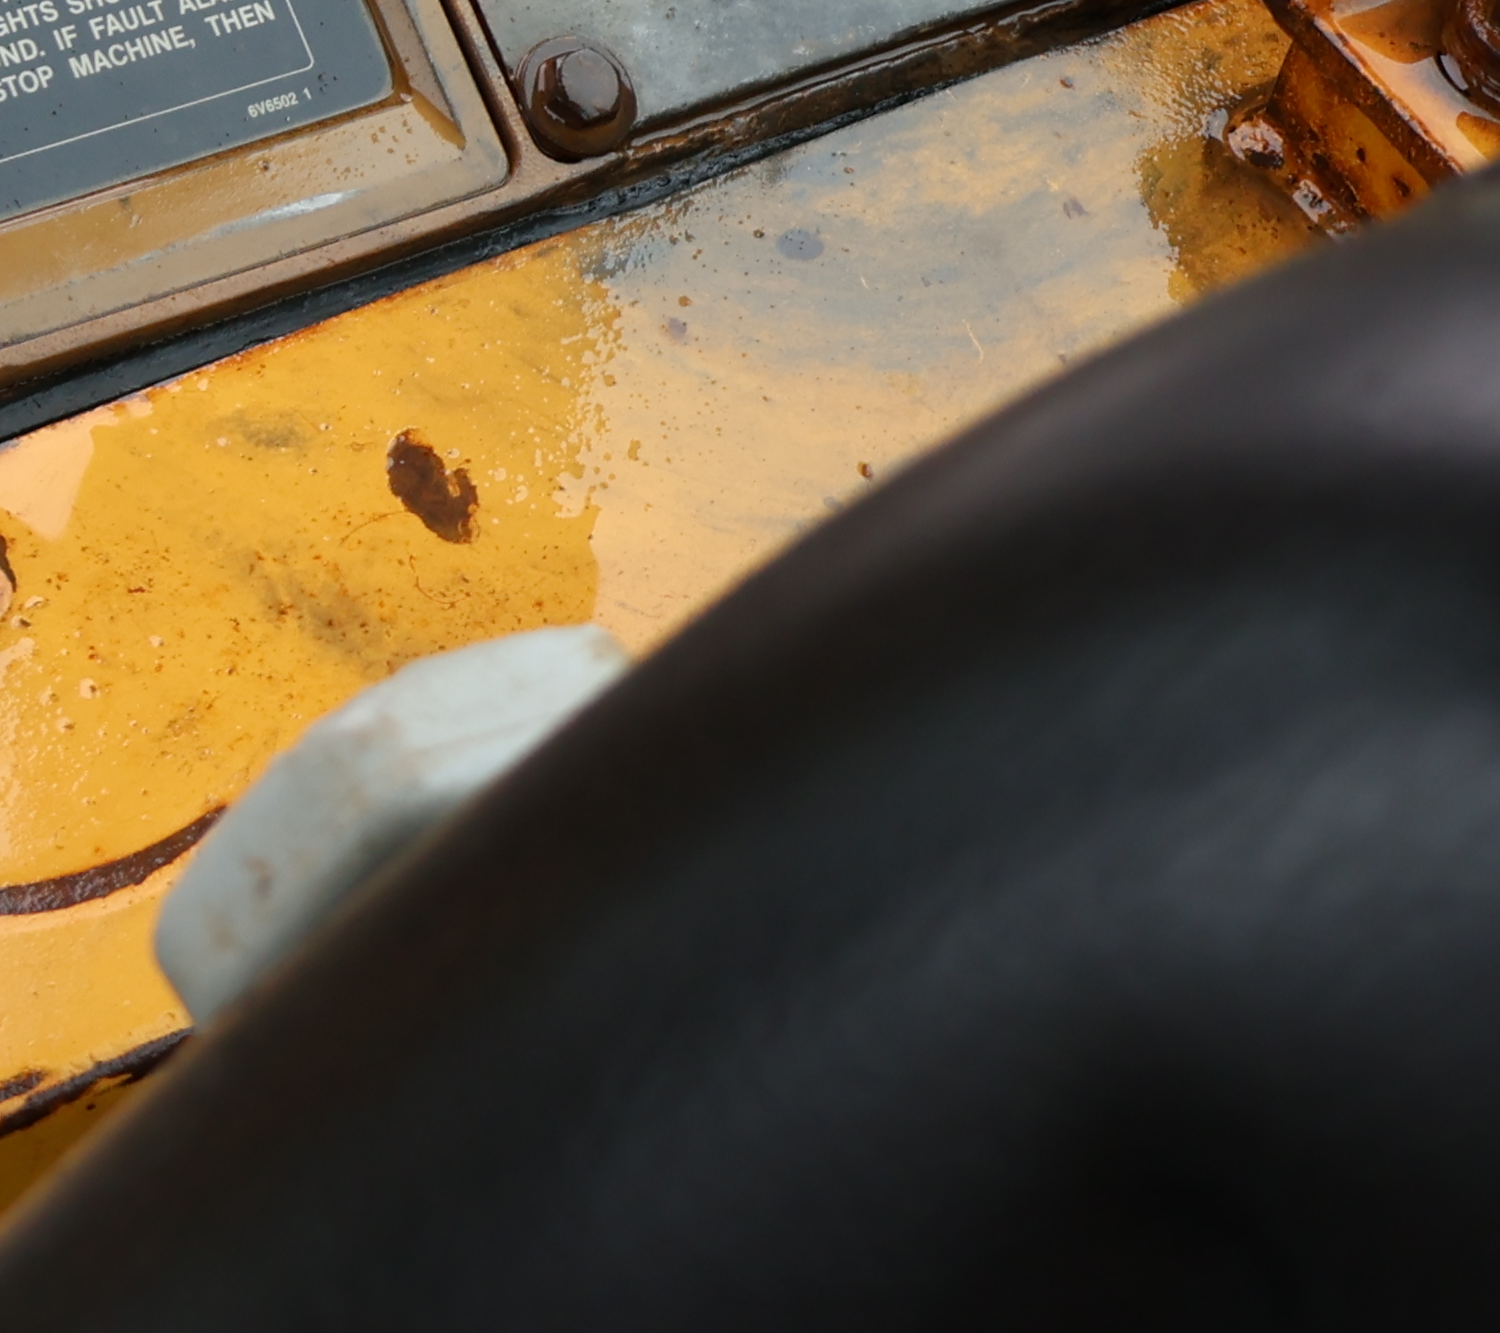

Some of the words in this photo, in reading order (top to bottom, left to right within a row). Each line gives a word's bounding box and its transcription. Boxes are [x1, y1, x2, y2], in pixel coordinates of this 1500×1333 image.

[53, 24, 78, 52] IF
[88, 0, 165, 41] FAULT
[68, 24, 196, 78] MACHINE,
[203, 0, 276, 38] THEN
[247, 91, 299, 118] 6V6502
